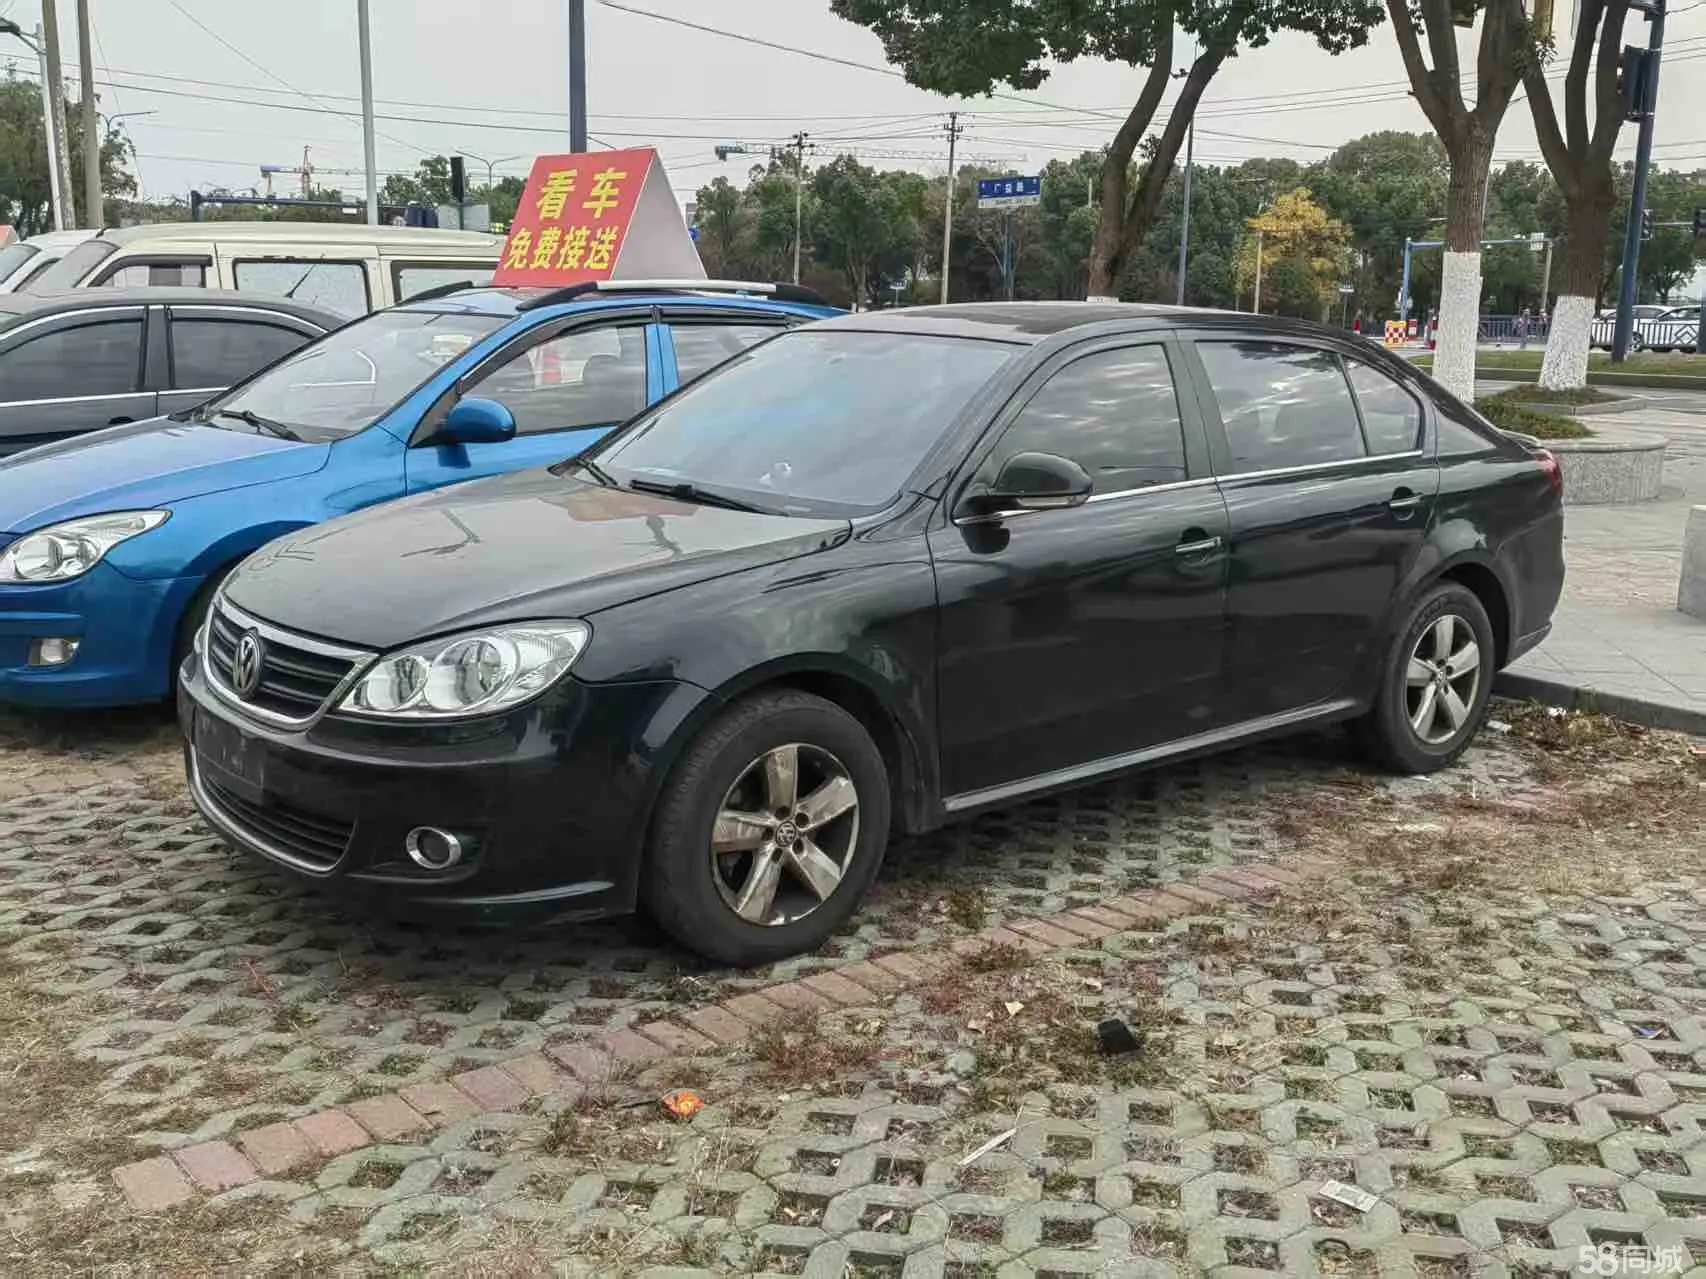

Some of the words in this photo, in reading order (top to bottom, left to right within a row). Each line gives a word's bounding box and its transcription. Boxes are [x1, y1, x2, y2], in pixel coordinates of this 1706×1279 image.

[536, 167, 627, 220] 看车
[503, 224, 619, 271] 免费接送
